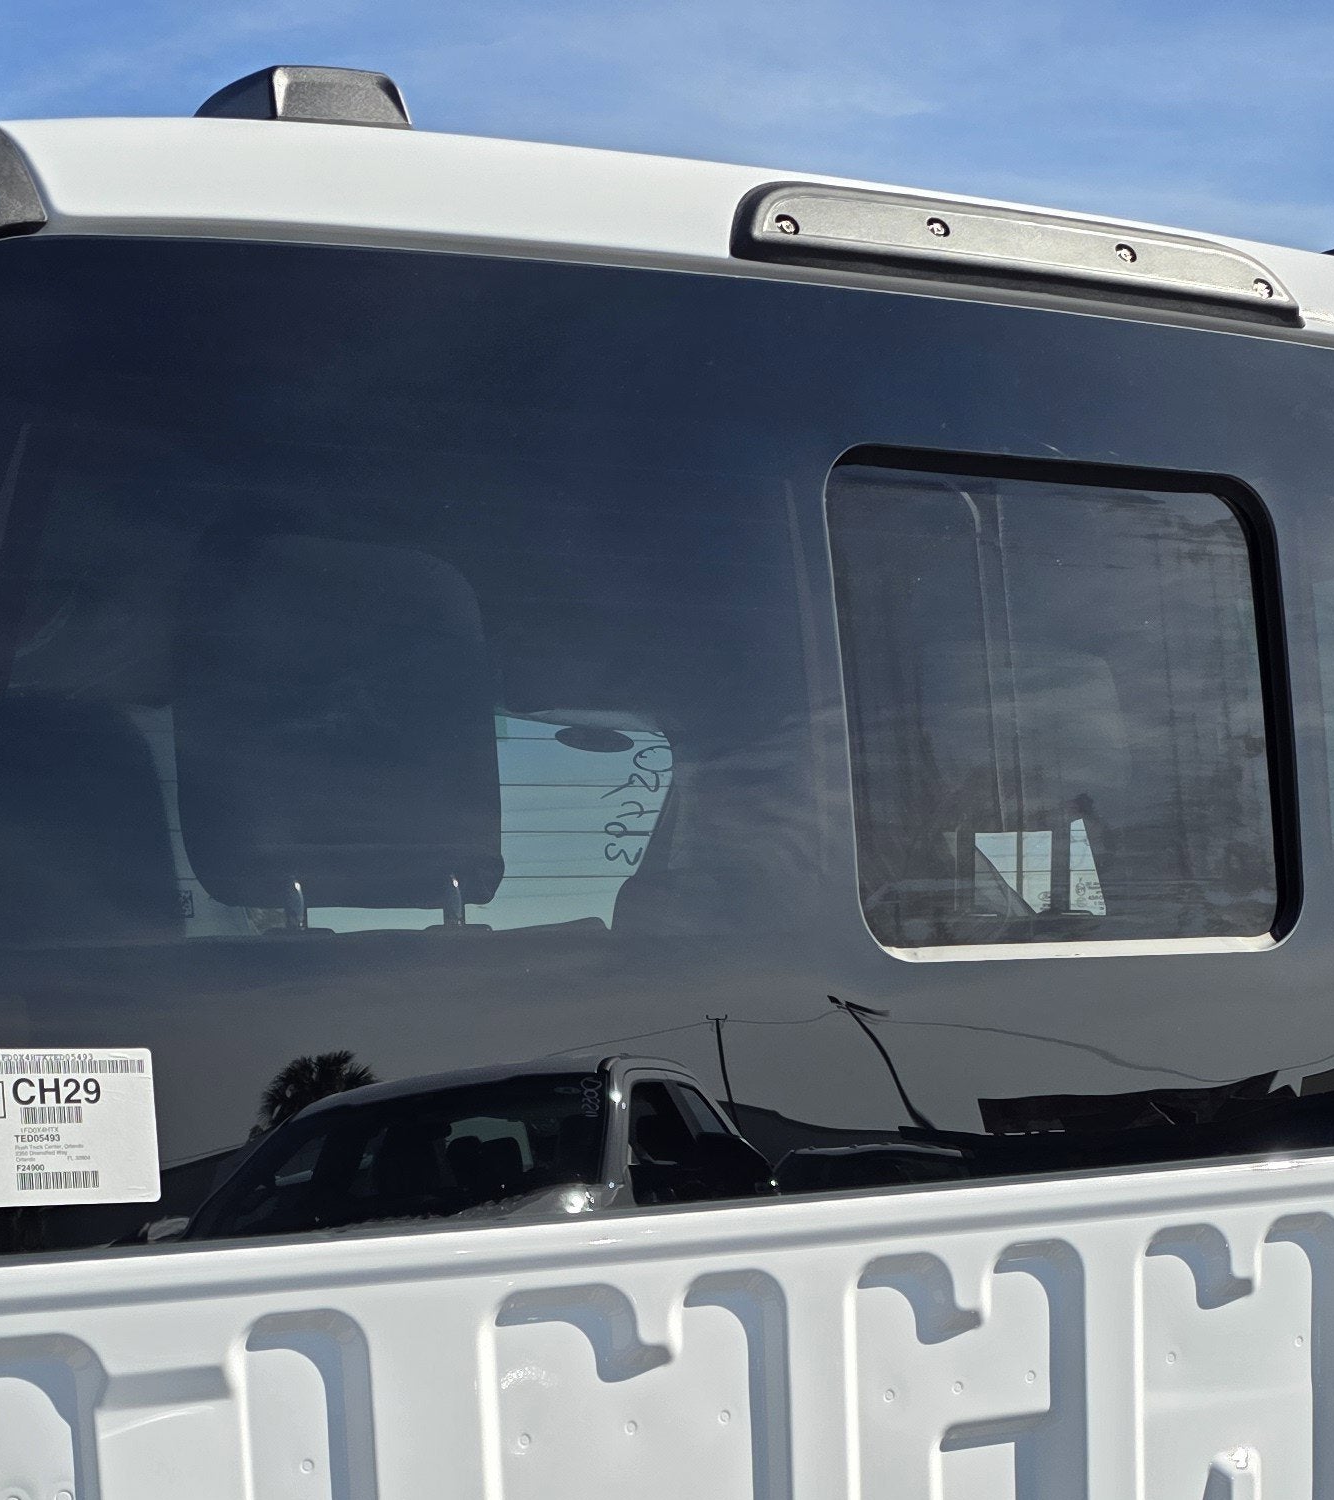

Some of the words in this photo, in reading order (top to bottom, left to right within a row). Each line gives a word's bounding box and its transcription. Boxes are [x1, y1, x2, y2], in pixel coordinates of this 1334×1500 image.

[12, 1077, 101, 1106] CH29
[14, 1134, 61, 1143] TED05493
[16, 1164, 45, 1172] F24900
